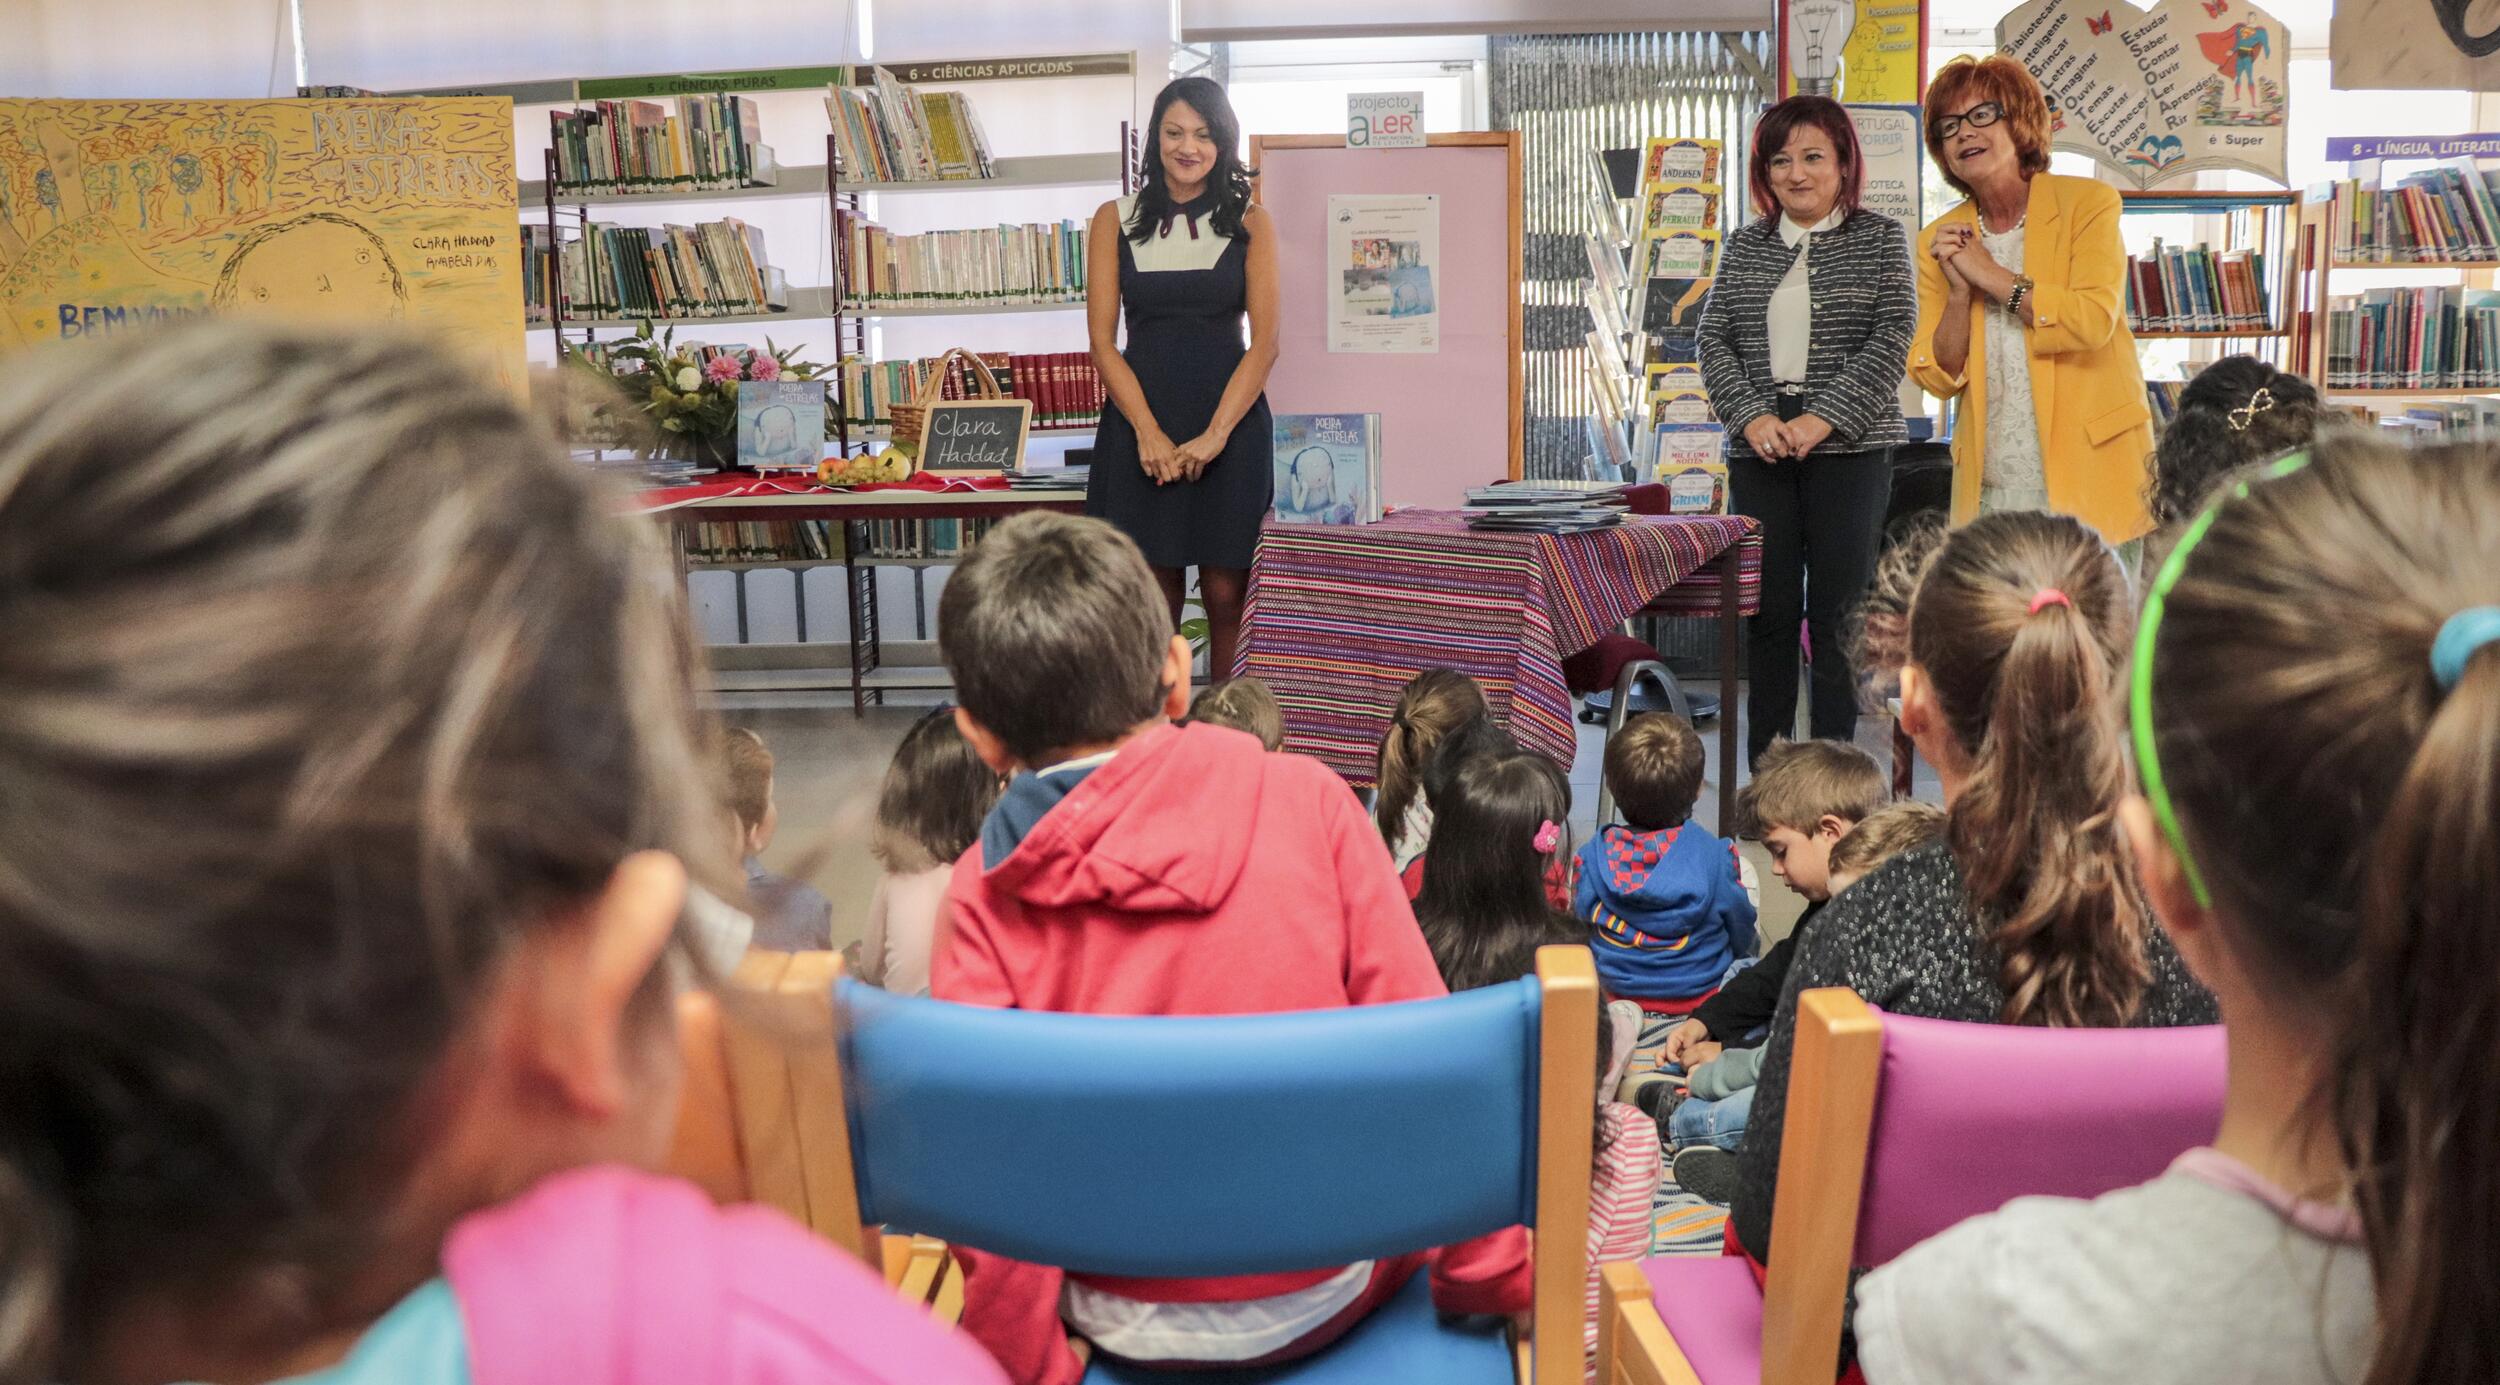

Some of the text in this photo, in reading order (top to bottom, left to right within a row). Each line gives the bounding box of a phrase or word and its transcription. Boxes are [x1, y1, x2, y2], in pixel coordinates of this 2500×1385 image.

[2022, 13, 2068, 65] nteligente
[2120, 12, 2169, 46] Estudar
[2130, 32, 2168, 58] Saber
[2029, 38, 2069, 79] Brincar
[2138, 42, 2180, 72] Contar
[909, 69, 918, 80] 6
[932, 64, 993, 79] CIÊNCIAS
[998, 61, 1073, 76] APLICADAS
[2040, 54, 2078, 90] Letras
[2052, 53, 2098, 100] Imaginar
[2144, 61, 2180, 86] Ouvir
[647, 82, 656, 93] 5
[734, 75, 777, 88] PURAS
[2064, 79, 2097, 110] Ouvir
[2151, 82, 2175, 100] Ler
[1348, 95, 1410, 112] projecto
[2075, 85, 2115, 120] Temas
[2086, 92, 2129, 135] Escutar
[312, 108, 422, 152] POEIRA
[1856, 118, 1909, 131] RTUGAL
[2097, 97, 2150, 146] Conhecer
[2165, 113, 2188, 131] Rir
[2109, 121, 2147, 158] Alegre
[2209, 134, 2264, 147] é Super
[2352, 143, 2362, 155] 8
[2376, 140, 2434, 156] LÍNGUA,
[346, 154, 494, 198] ESTRELAS
[1662, 168, 1702, 179] ANDERSEN
[1863, 193, 1909, 203] MOTORA
[1662, 215, 1702, 225] PERRAULT
[1887, 206, 1916, 217] ORAL
[412, 234, 496, 251] CLARA HADDAD
[426, 254, 497, 269] ANABELA DIAS
[59, 303, 128, 341] BEM
[779, 382, 804, 393] POEIRA
[934, 409, 1002, 437] Clara
[1315, 417, 1342, 430] POEIRA
[1322, 430, 1359, 444] ESTRELAS
[938, 437, 1012, 468] Haddad
[1672, 494, 1710, 506] GRIMM
